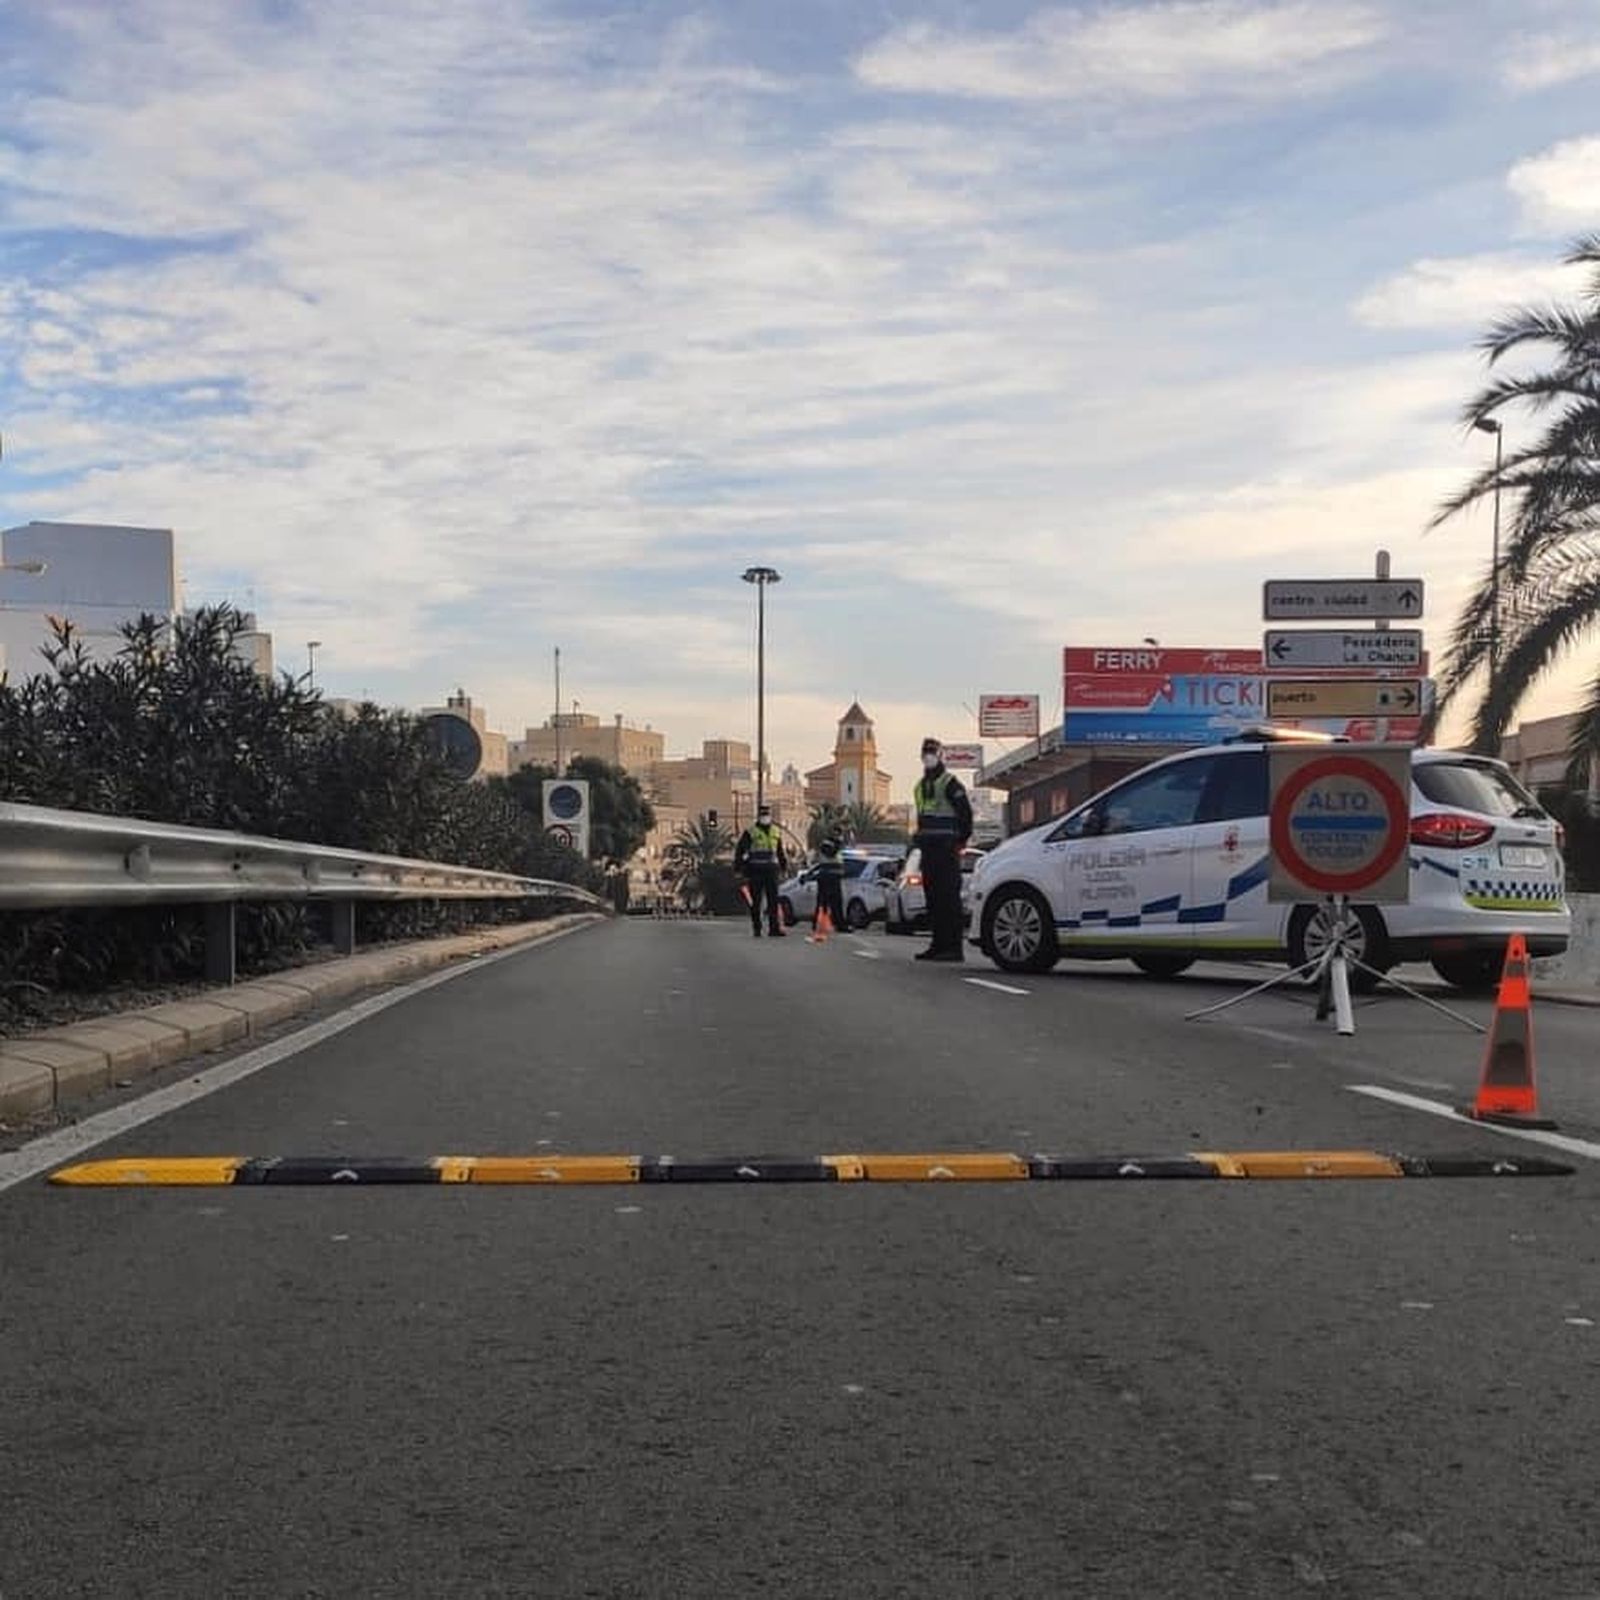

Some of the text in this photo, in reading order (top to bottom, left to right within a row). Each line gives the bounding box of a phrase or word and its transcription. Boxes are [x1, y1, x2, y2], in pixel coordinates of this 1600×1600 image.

[1093, 651, 1165, 670] FERRY
[1343, 651, 1359, 662] La
[1306, 791, 1369, 811] ALTO
